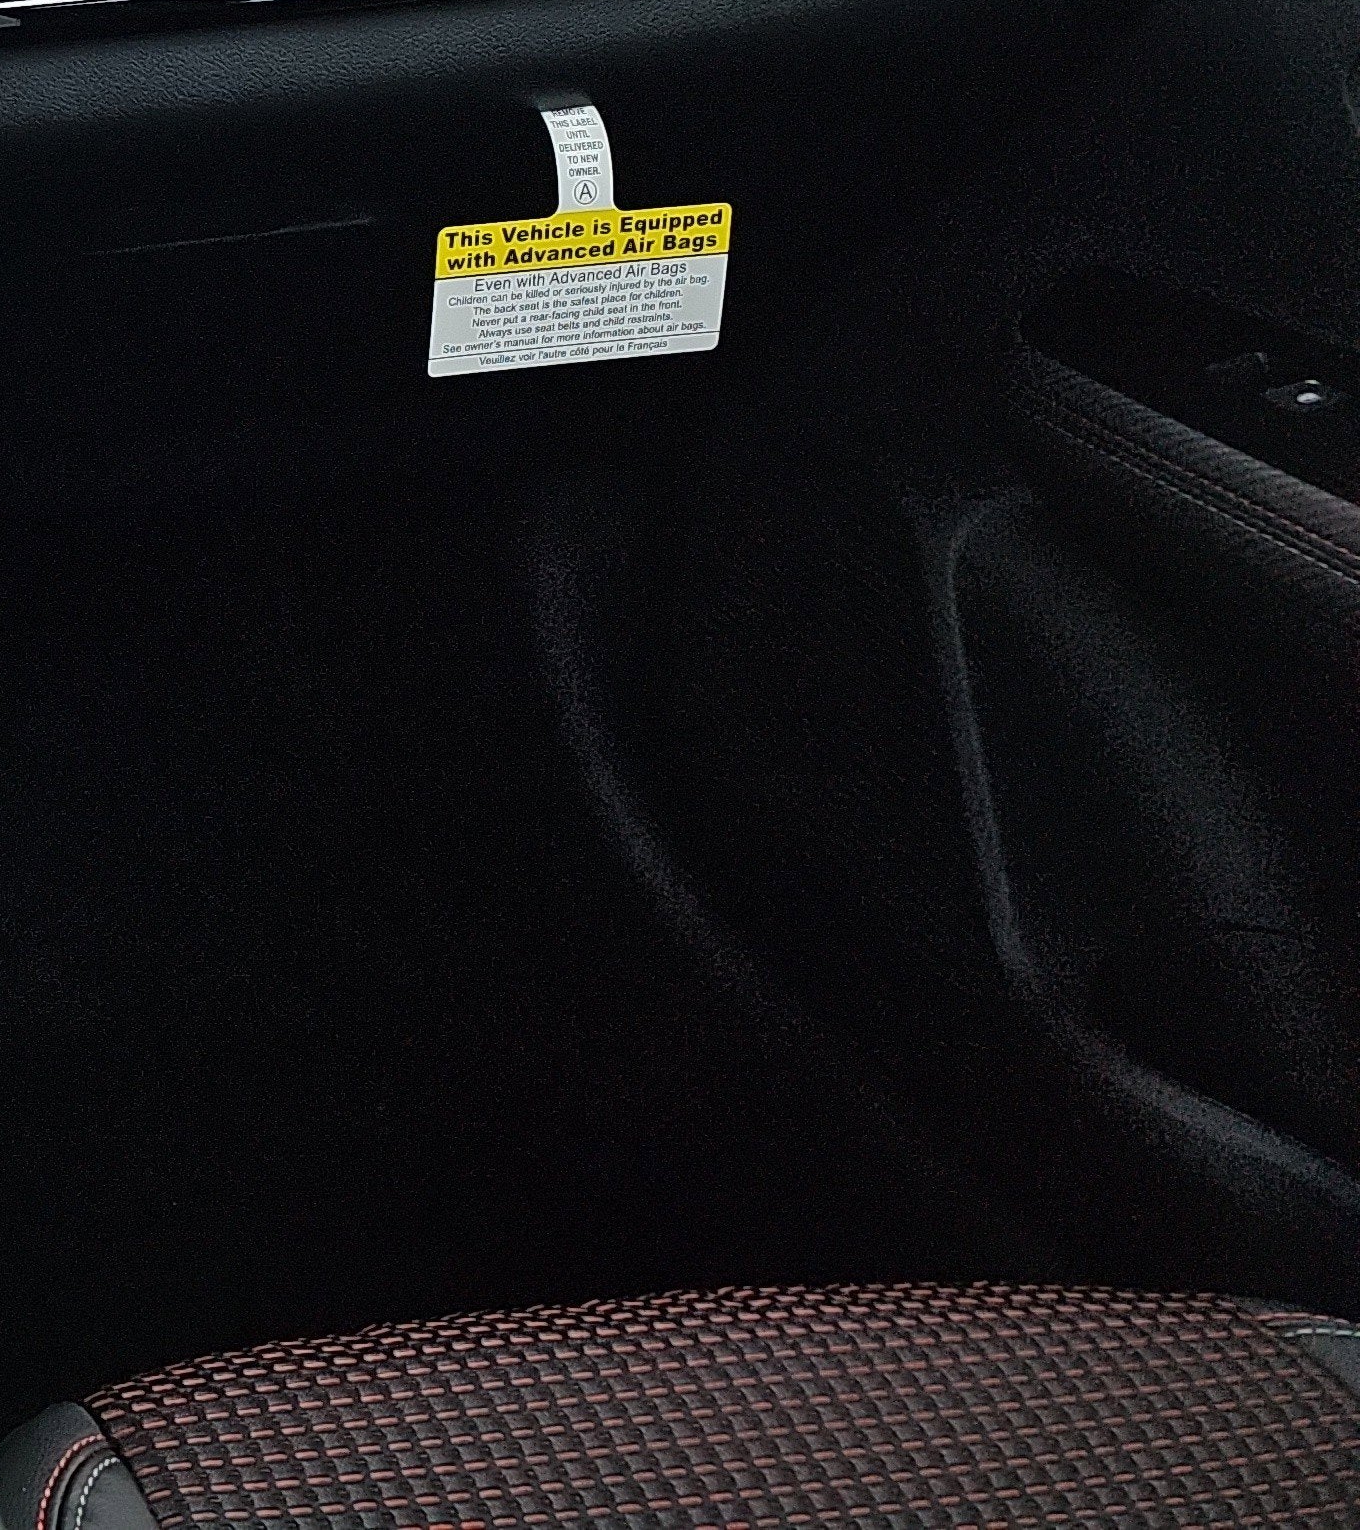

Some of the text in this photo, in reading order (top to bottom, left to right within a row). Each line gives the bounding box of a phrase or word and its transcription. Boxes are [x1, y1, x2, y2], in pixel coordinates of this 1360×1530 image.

[571, 117, 598, 127] LABEL
[558, 141, 604, 153] DELIVERED
[566, 130, 591, 140] UNTIL
[567, 153, 599, 164] TO NEW
[569, 166, 601, 178] OWNER.
[445, 208, 723, 249] This Vehicle is Equipped
[447, 234, 717, 270] with Advanced Air Bags
[474, 262, 687, 293] Even with Advanced Air Bags
[448, 295, 488, 307] Children
[491, 294, 508, 303] can
[510, 290, 523, 301] be
[525, 287, 550, 299] killed
[552, 288, 563, 297] or
[564, 284, 608, 296] seriously
[609, 280, 641, 293] injured
[643, 277, 655, 290] by
[657, 276, 672, 287] the
[675, 275, 687, 285] air
[471, 316, 501, 328] Never
[503, 315, 519, 327] put
[529, 310, 581, 322] rear-facing
[582, 305, 605, 317] child
[607, 303, 628, 314] seat
[629, 302, 639, 313] in
[641, 301, 656, 311] the
[473, 305, 491, 316] The
[493, 302, 517, 314] back
[519, 301, 540, 312] seat
[542, 300, 550, 309] is
[552, 298, 568, 309] the
[569, 295, 599, 307] safest
[601, 293, 627, 305] place
[629, 292, 642, 302] for
[442, 344, 462, 354] See
[503, 335, 539, 349] manual
[541, 334, 555, 344] for
[556, 332, 581, 343] more
[583, 326, 635, 340] information
[637, 323, 664, 335] about
[666, 322, 679, 331] air
[478, 327, 512, 339] Always
[514, 325, 532, 335] use
[534, 322, 556, 333] seat
[557, 320, 580, 331] belts
[582, 318, 601, 329] and
[602, 315, 625, 326] child
[518, 351, 536, 361] voir
[591, 343, 614, 356] pour
[616, 342, 625, 352] le
[627, 339, 668, 352] Français
